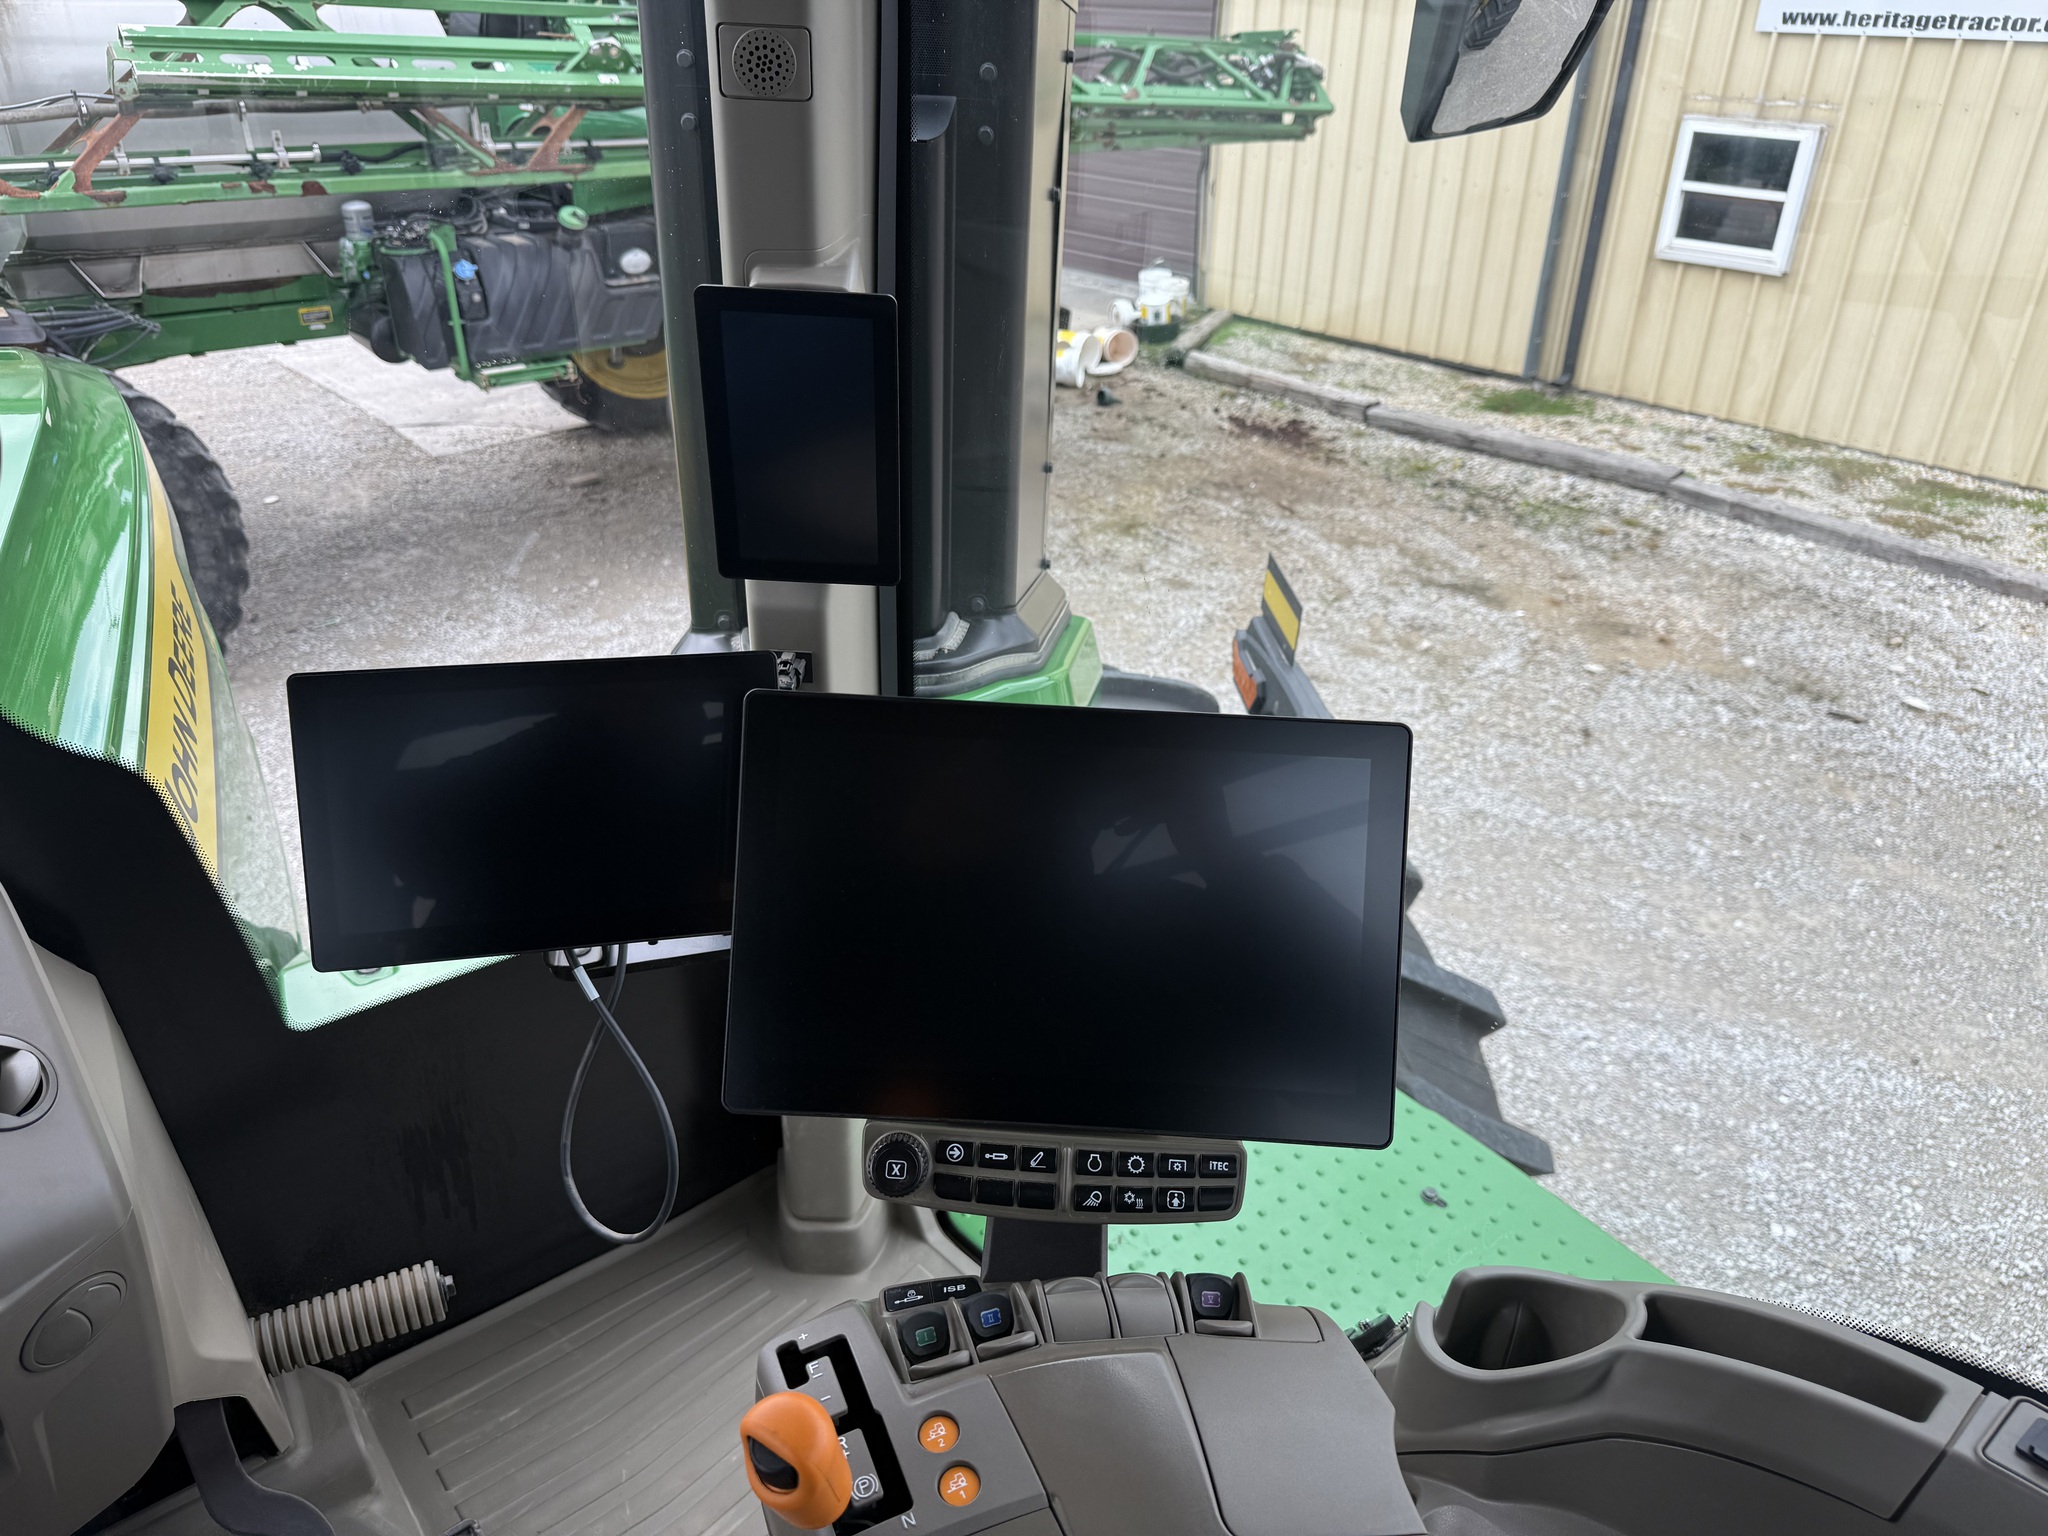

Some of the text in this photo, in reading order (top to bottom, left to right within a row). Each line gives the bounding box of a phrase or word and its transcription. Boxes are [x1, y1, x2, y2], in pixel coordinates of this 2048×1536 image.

[168, 579, 197, 726] DEERE
[891, 1163, 901, 1176] X
[1209, 1160, 1229, 1171] iTEC
[943, 1284, 966, 1293] ISB
[808, 1360, 819, 1374] F
[838, 1436, 849, 1449] R
[937, 1438, 946, 1447] 2
[858, 1479, 869, 1495] P
[959, 1490, 967, 1499] 1
[901, 1511, 917, 1530] N
